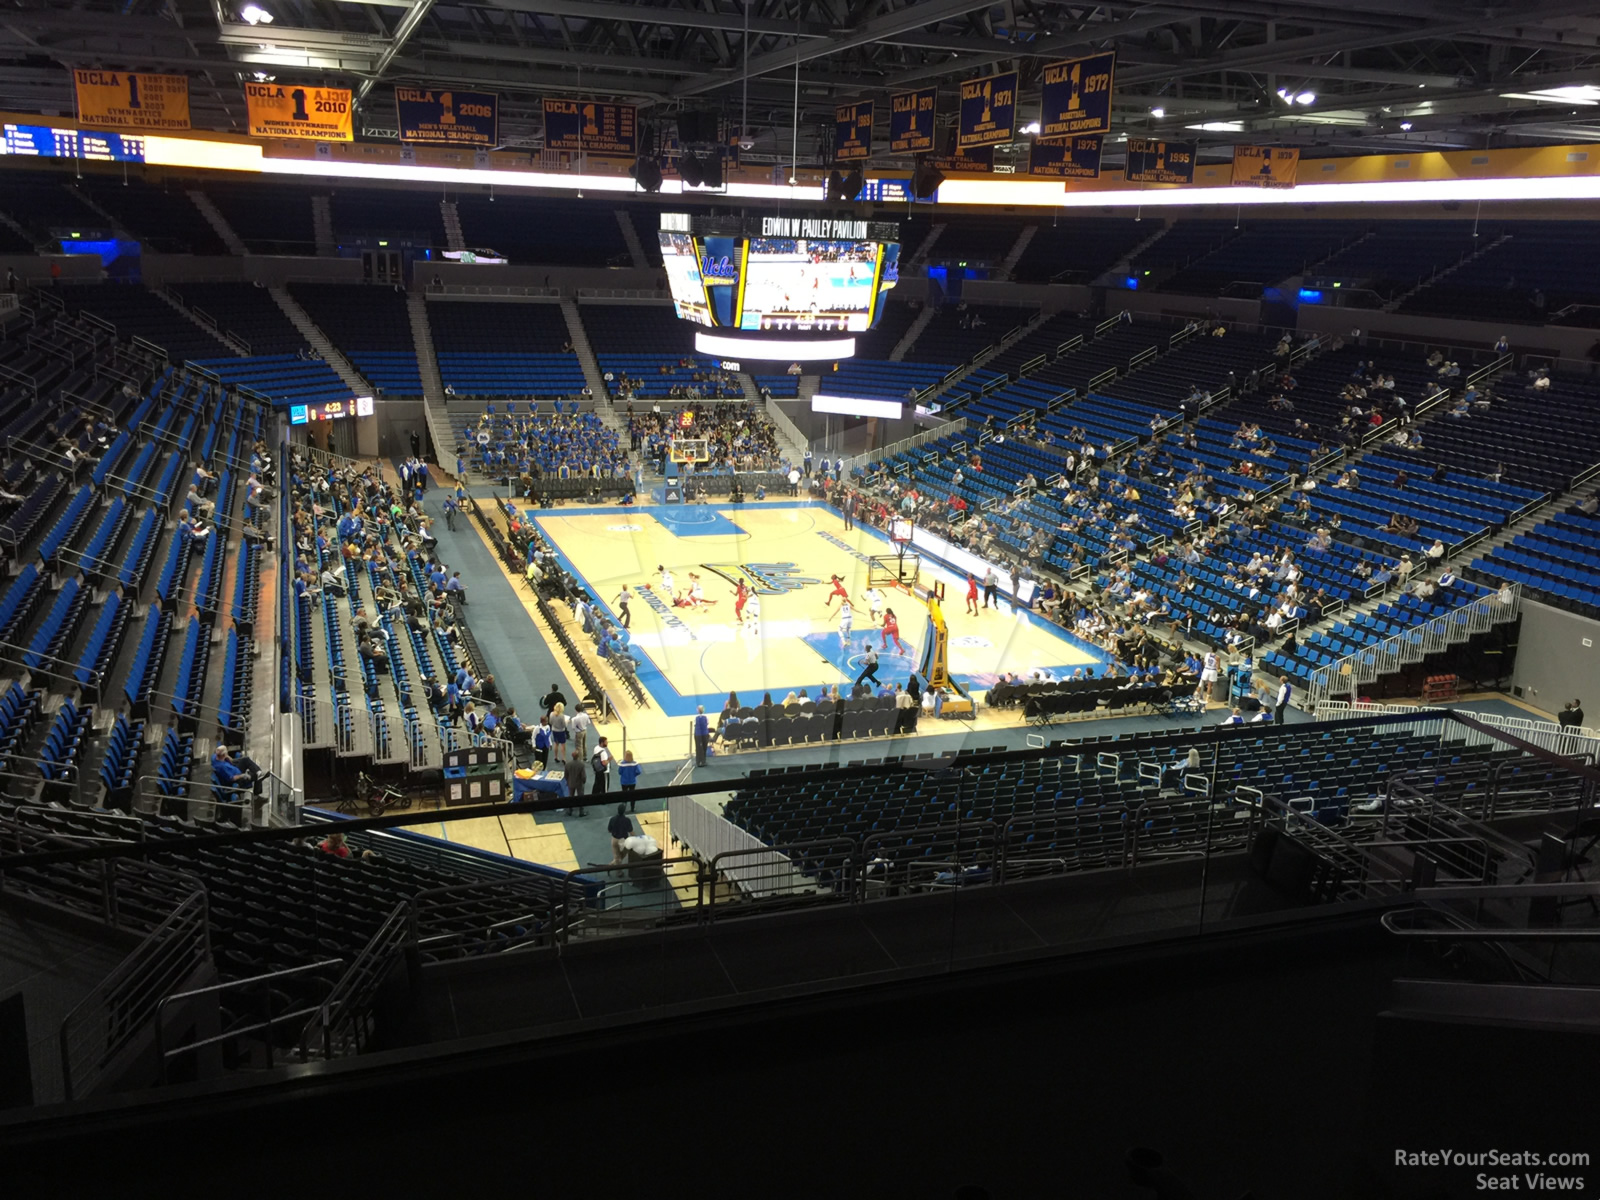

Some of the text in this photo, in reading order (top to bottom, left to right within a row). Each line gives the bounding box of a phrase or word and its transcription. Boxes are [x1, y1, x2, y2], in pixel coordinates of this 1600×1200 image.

[77, 72, 141, 108] UCLA 1
[1045, 64, 1109, 110] UCLA 1 1972
[248, 86, 309, 120] UCLA 1
[315, 101, 346, 113] 2010
[398, 90, 492, 124] UCLA 1 2006
[893, 97, 911, 112] UCLA
[919, 96, 933, 112] 1970
[962, 81, 1012, 122] UCLA 1 1971
[107, 108, 163, 118] GYMNASTICS
[546, 101, 598, 135] UCLA 1
[82, 114, 188, 127] NATIONAL CHAMPIONS
[256, 127, 346, 138] NATIONAL CHAMPIONS
[406, 130, 489, 142] NATIONAL CHAMPIONS
[551, 140, 631, 151] NATIONAL CHAMPIONS
[1077, 139, 1097, 150] 1975
[1129, 141, 1190, 169] UCLA 1 1995
[1237, 147, 1261, 158] UCLA
[1260, 148, 1272, 175] 1
[955, 161, 987, 170] CHAMPIONS
[1033, 166, 1095, 176] NATIONAL CHAMPIONS
[762, 217, 867, 239] EDWIN W PAULEY PAVILION
[325, 402, 341, 412] 4:23
